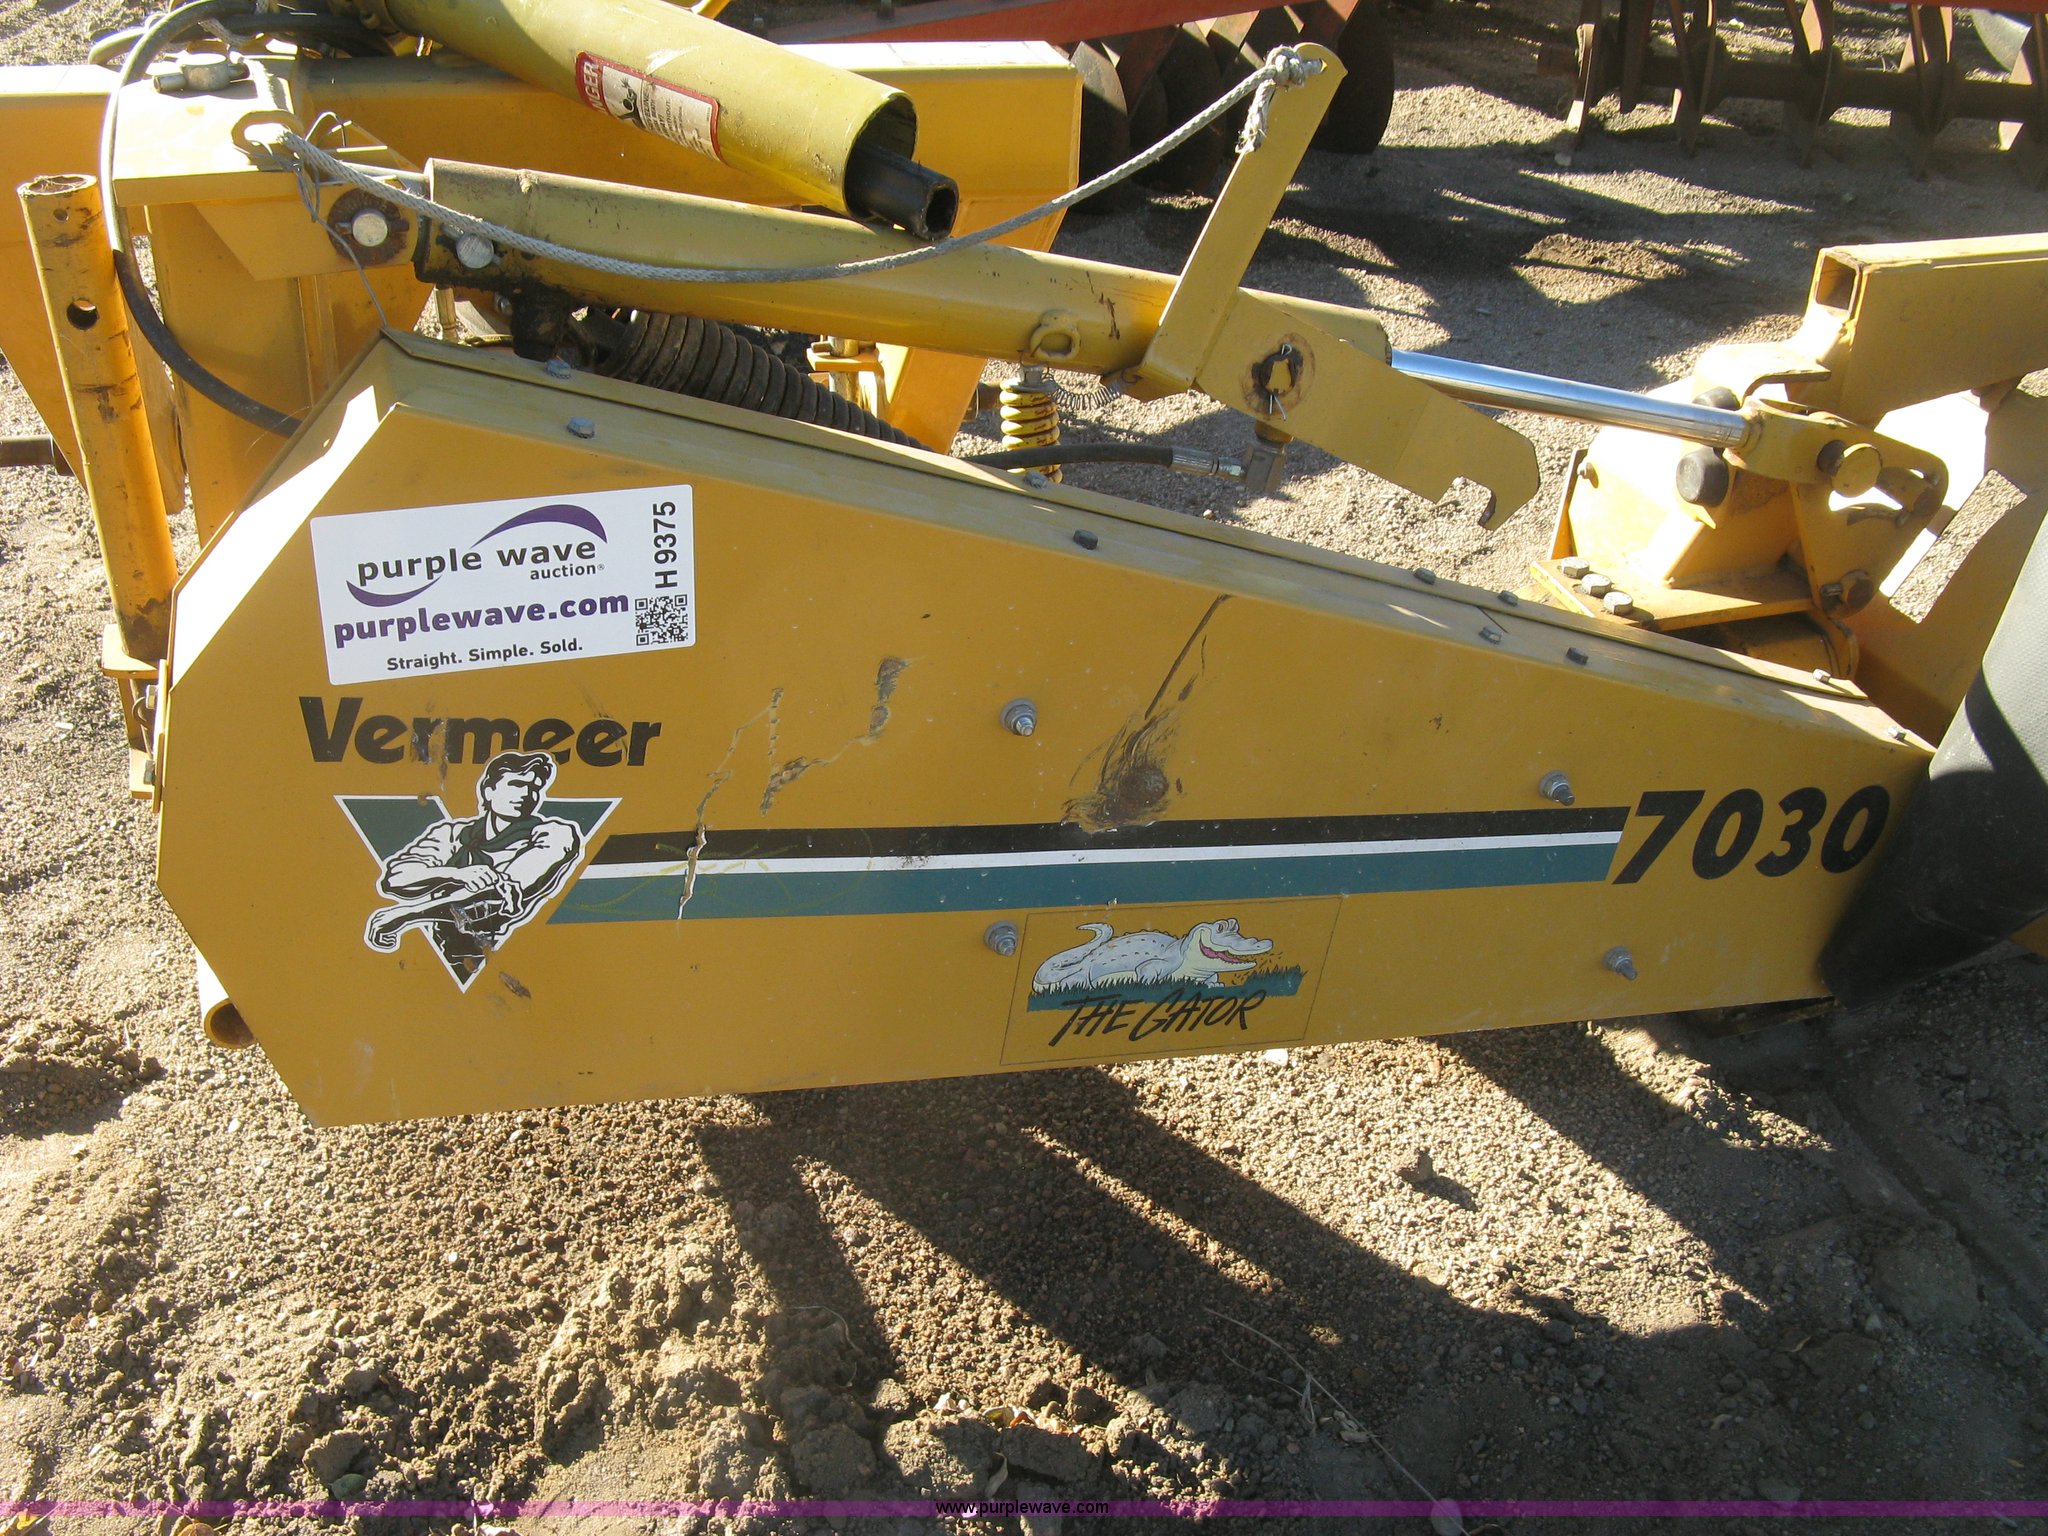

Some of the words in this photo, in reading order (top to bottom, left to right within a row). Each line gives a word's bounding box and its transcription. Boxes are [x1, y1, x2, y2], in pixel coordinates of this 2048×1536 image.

[582, 60, 606, 114] NGER
[652, 501, 677, 564] 9375
[357, 548, 482, 586] purple
[496, 539, 597, 567] wave
[655, 569, 678, 589] H
[333, 594, 630, 648] purplewave.com
[387, 649, 463, 671] Straight.
[469, 644, 534, 663] Simple.
[540, 638, 584, 655] Sold.
[299, 696, 662, 767] Vermeer
[1611, 785, 1891, 885] 7030
[1047, 993, 1137, 1047] THE
[1128, 989, 1267, 1042] GATOR
